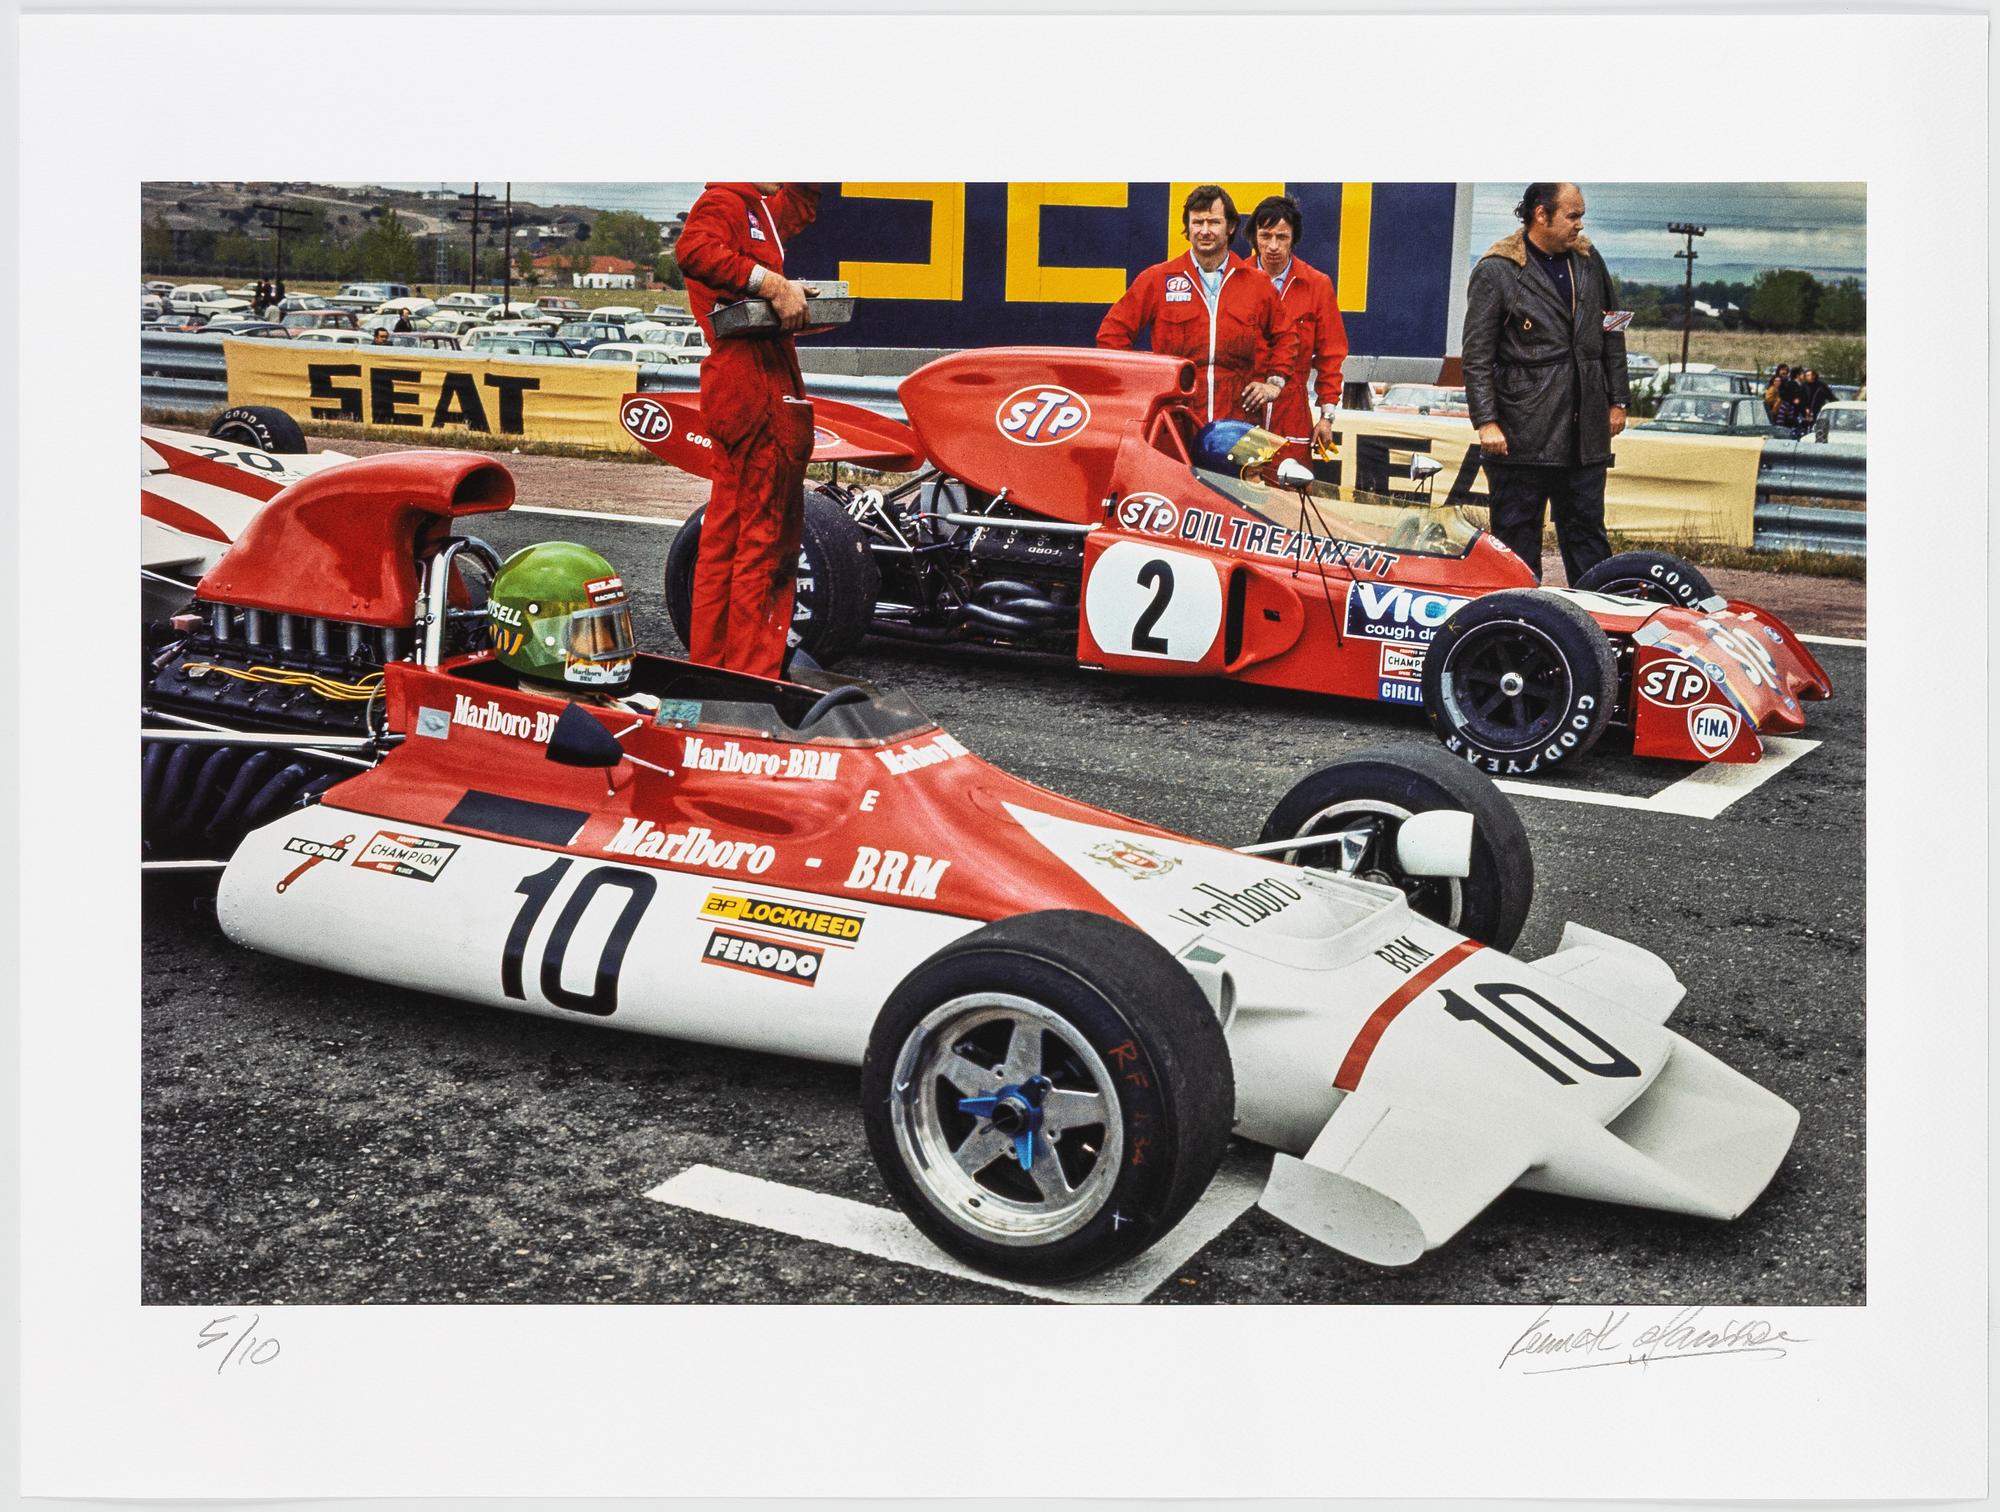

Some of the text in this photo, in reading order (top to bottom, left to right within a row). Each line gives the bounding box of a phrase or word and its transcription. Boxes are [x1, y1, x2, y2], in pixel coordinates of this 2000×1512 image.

[308, 364, 540, 434] SEAT
[626, 403, 668, 435] STP
[1003, 392, 1082, 439] STP
[686, 432, 713, 448] GOO
[1122, 497, 1172, 530] STP
[1181, 508, 1399, 577] OIL TREATMENT
[1132, 558, 1175, 655] 2
[1357, 581, 1470, 628] VIC
[1364, 624, 1438, 641] cough dr
[1388, 656, 1421, 668] CHAMP
[1696, 618, 1777, 690] STP
[1382, 682, 1424, 702] GIRLI
[1644, 664, 1703, 701] STP
[1446, 694, 1595, 774] GOODYEAR
[1696, 717, 1729, 738] FINA
[682, 737, 841, 781] Marlboro-BRM
[860, 789, 880, 812] E
[287, 838, 345, 860] KONI
[371, 844, 442, 866] CHAMPION
[603, 817, 775, 875] Marlboro
[844, 846, 950, 900] BRM
[501, 857, 657, 1016] 10
[740, 901, 861, 938] LOCKHEED
[709, 935, 818, 977] FERODO
[1375, 935, 1435, 974] BRM
[1437, 982, 1642, 1086] 10
[197, 1312, 281, 1375] 5/10
